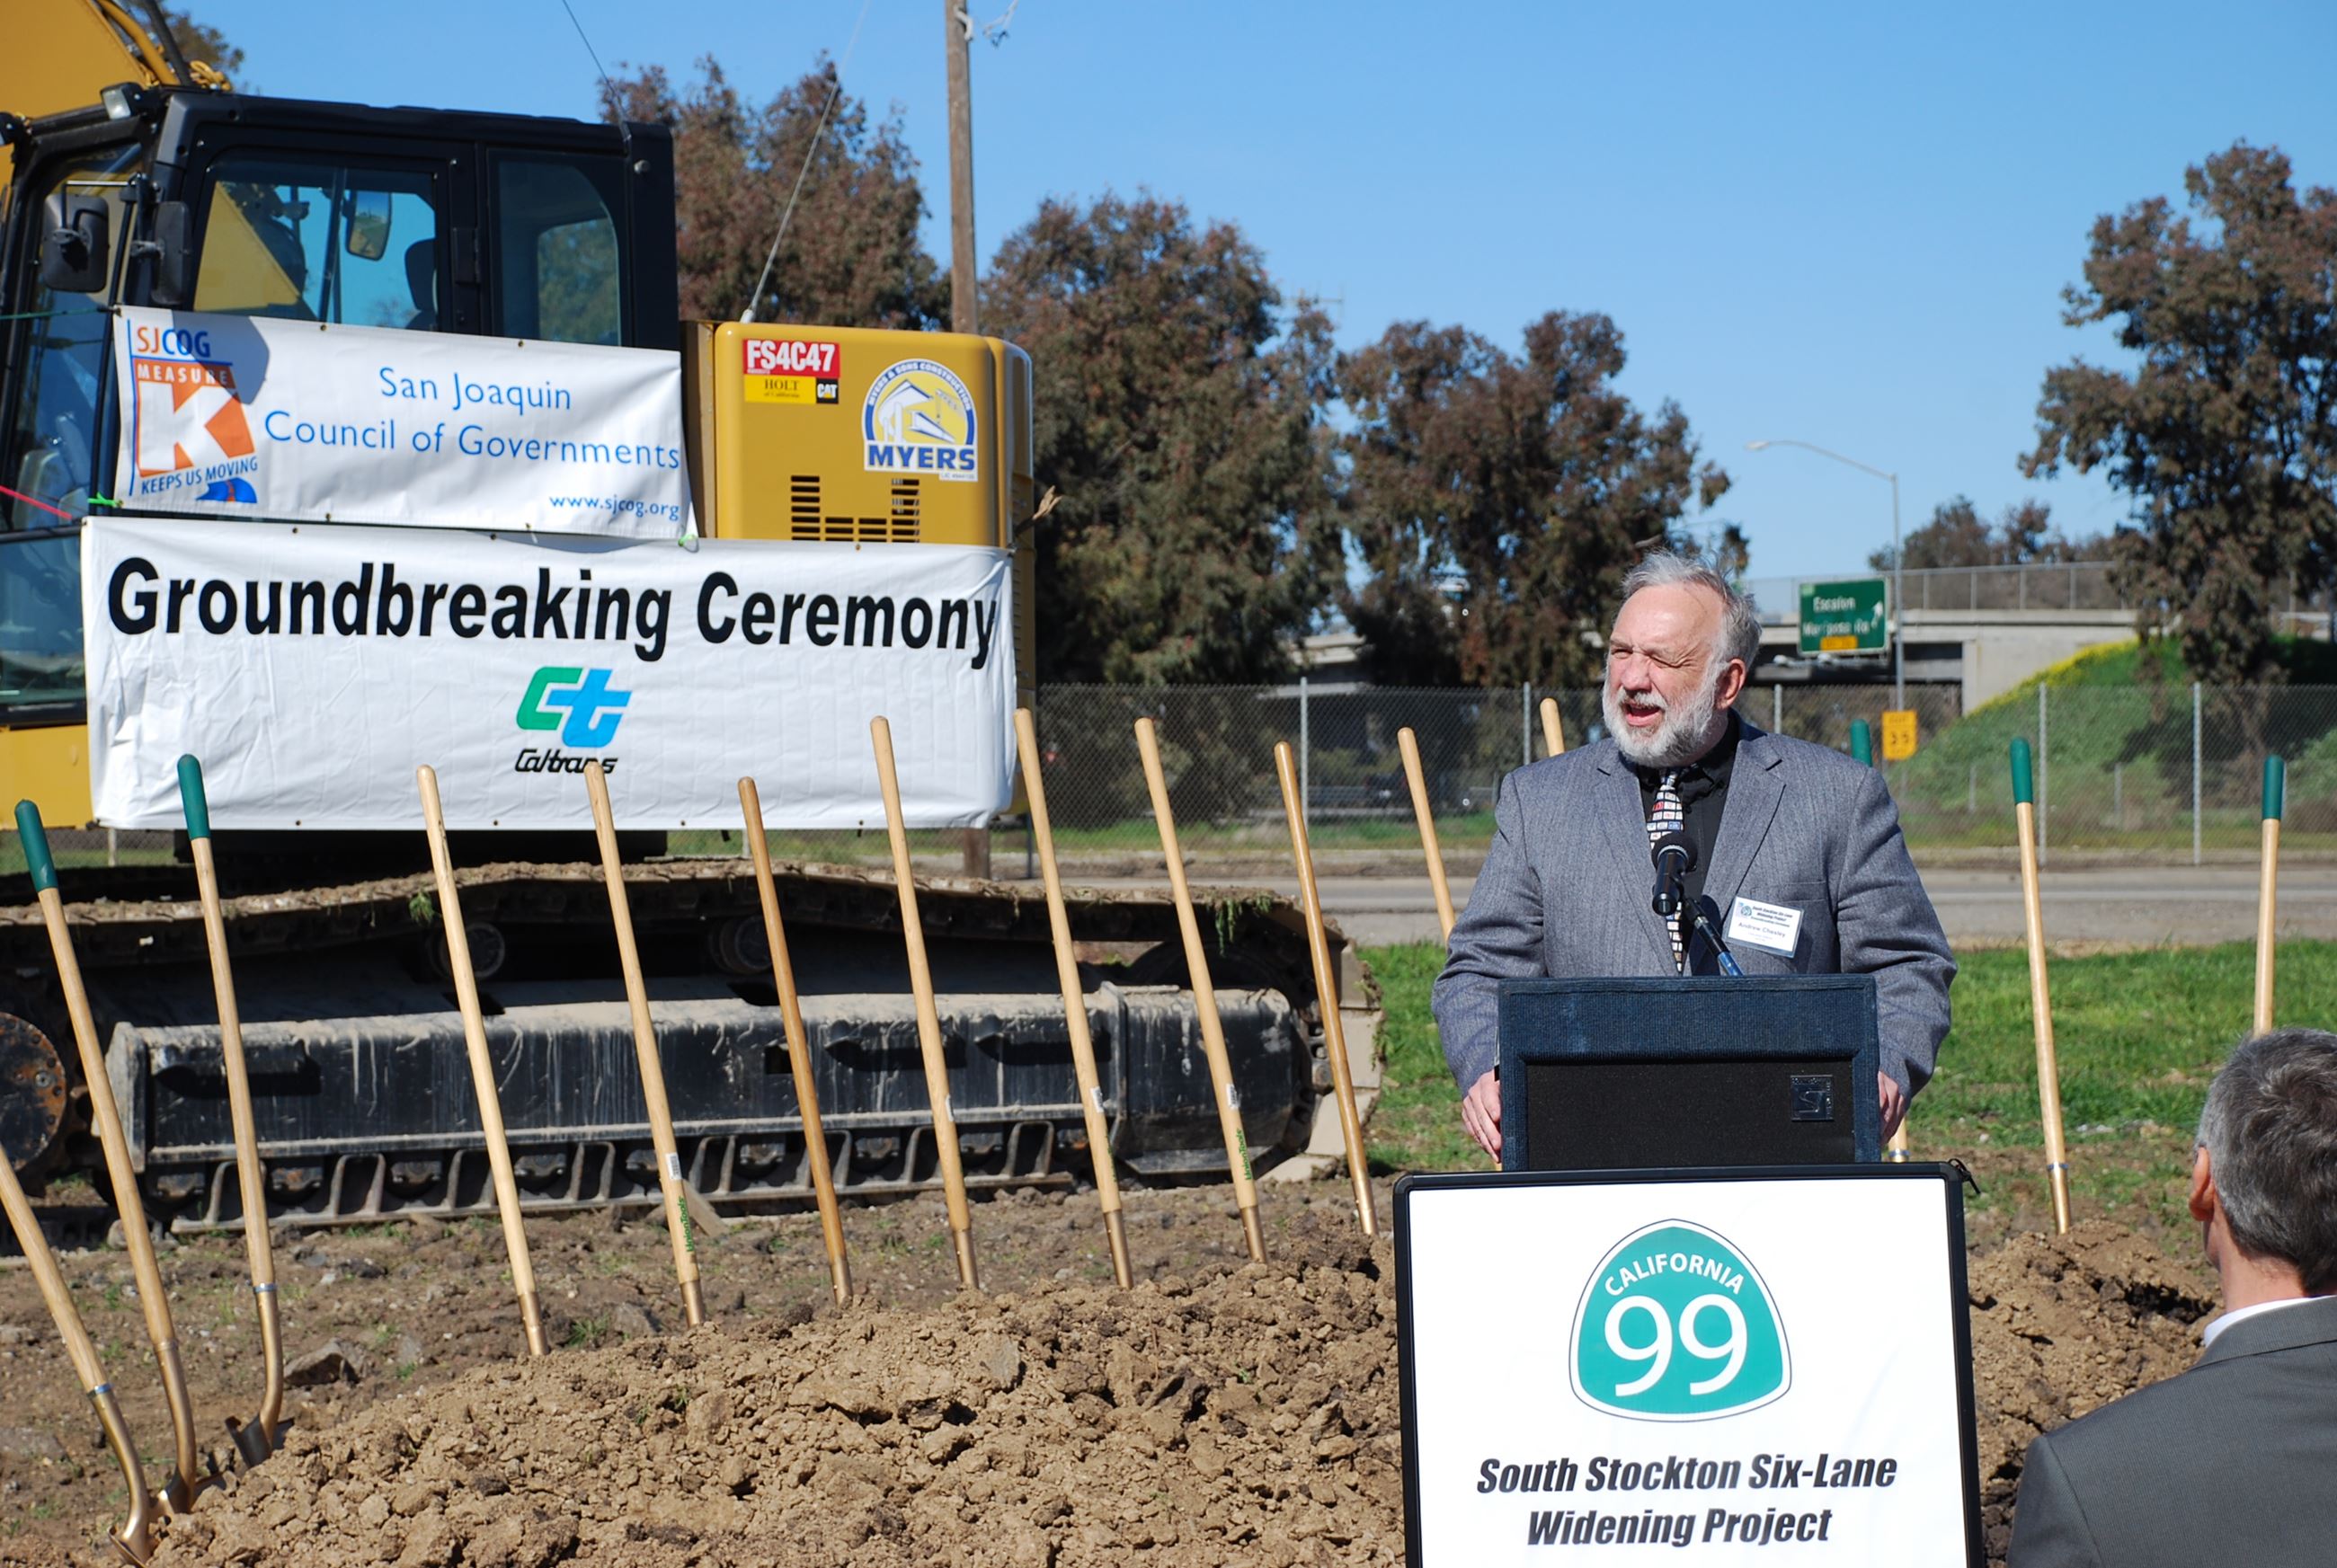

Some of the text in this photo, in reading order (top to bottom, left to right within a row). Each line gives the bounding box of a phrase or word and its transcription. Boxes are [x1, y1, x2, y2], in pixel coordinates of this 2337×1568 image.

[137, 326, 210, 358] SJCOG
[747, 340, 835, 372] FS4C47
[138, 363, 227, 385] MEASURE
[379, 367, 571, 416] San Joaquin
[764, 378, 800, 391] HOLT
[817, 384, 838, 398] CAT
[138, 380, 237, 472] K
[265, 410, 680, 469] Council of Governments
[141, 456, 258, 494] KEEPS US MOVING
[868, 445, 974, 470] MYERS
[549, 494, 680, 521] www.sjcog.org
[108, 557, 997, 669] Groundbreaking Ceremony
[1604, 1253, 1745, 1296] CALIFORNIA
[1604, 1293, 1747, 1396] 99
[1476, 1453, 1897, 1493] South Stockton Six-Lane
[1527, 1507, 1833, 1548] Widening Project
